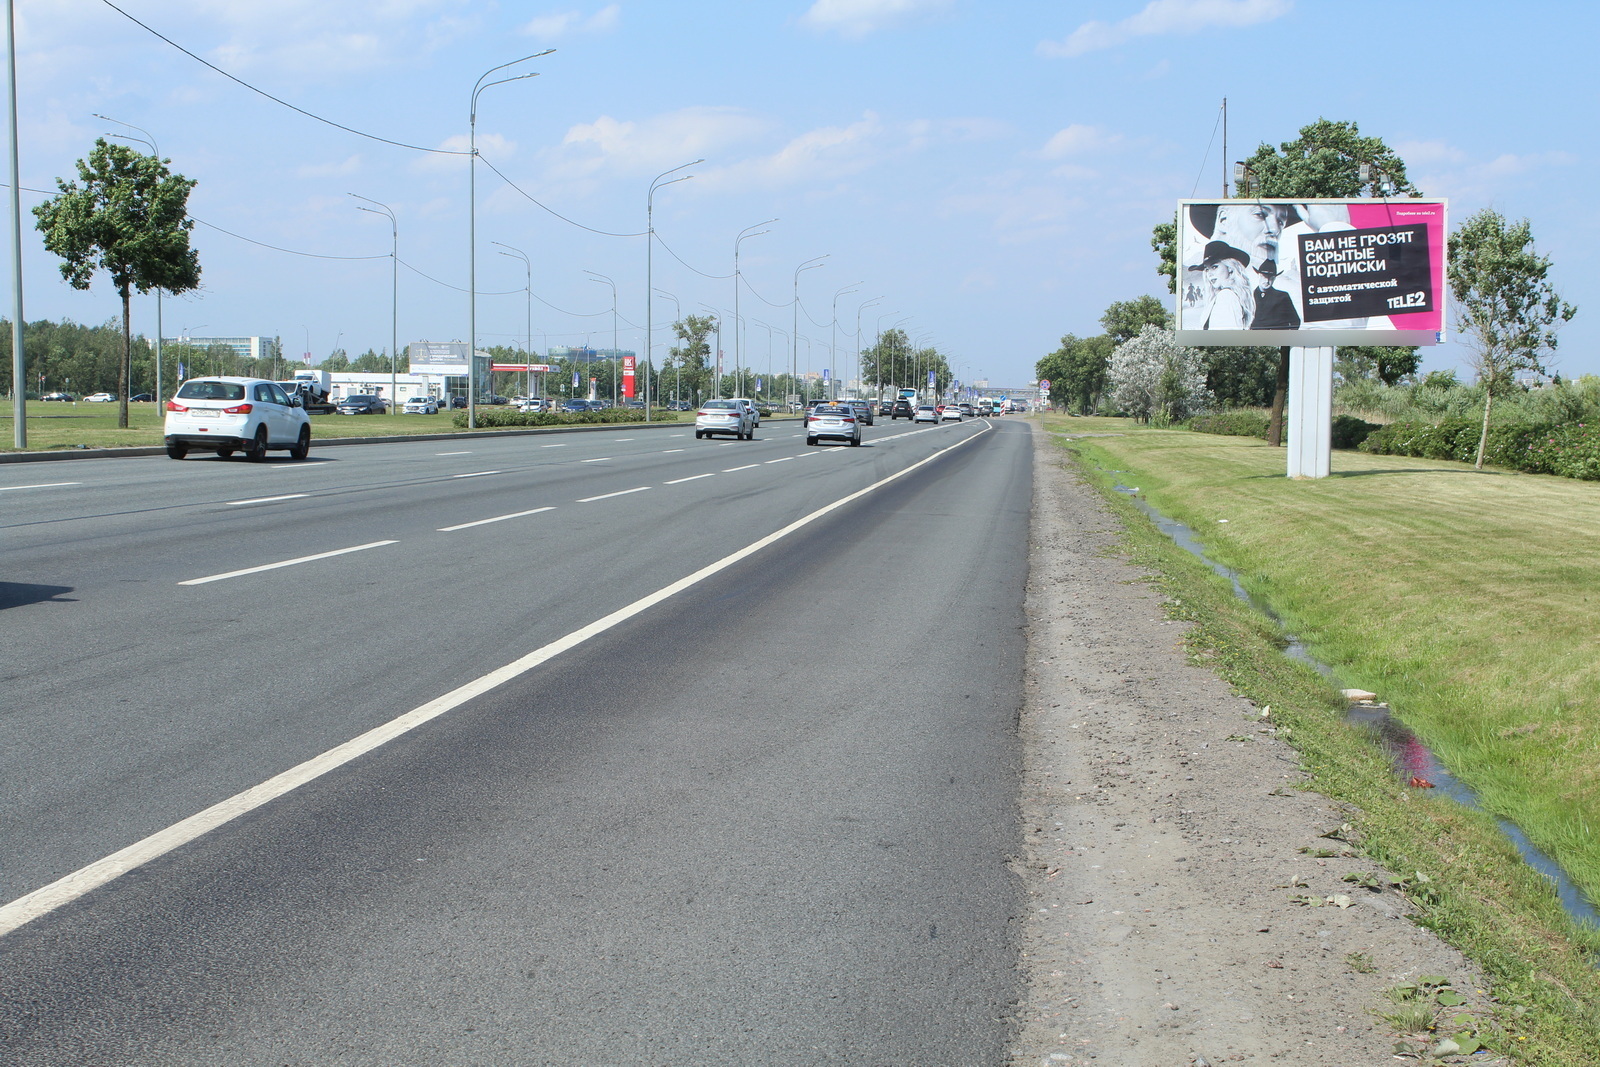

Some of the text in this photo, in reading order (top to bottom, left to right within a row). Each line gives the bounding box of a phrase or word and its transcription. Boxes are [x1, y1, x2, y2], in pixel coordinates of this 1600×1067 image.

[1304, 231, 1414, 252] ВАМ НЕ ГРОЗЯТ
[1305, 247, 1376, 265] СКРЫТЫЕ
[1306, 259, 1386, 278] ПОДПИСКИ
[1308, 278, 1398, 294] С автоматической
[1308, 293, 1352, 306] защитой
[1387, 291, 1426, 309] TELE2
